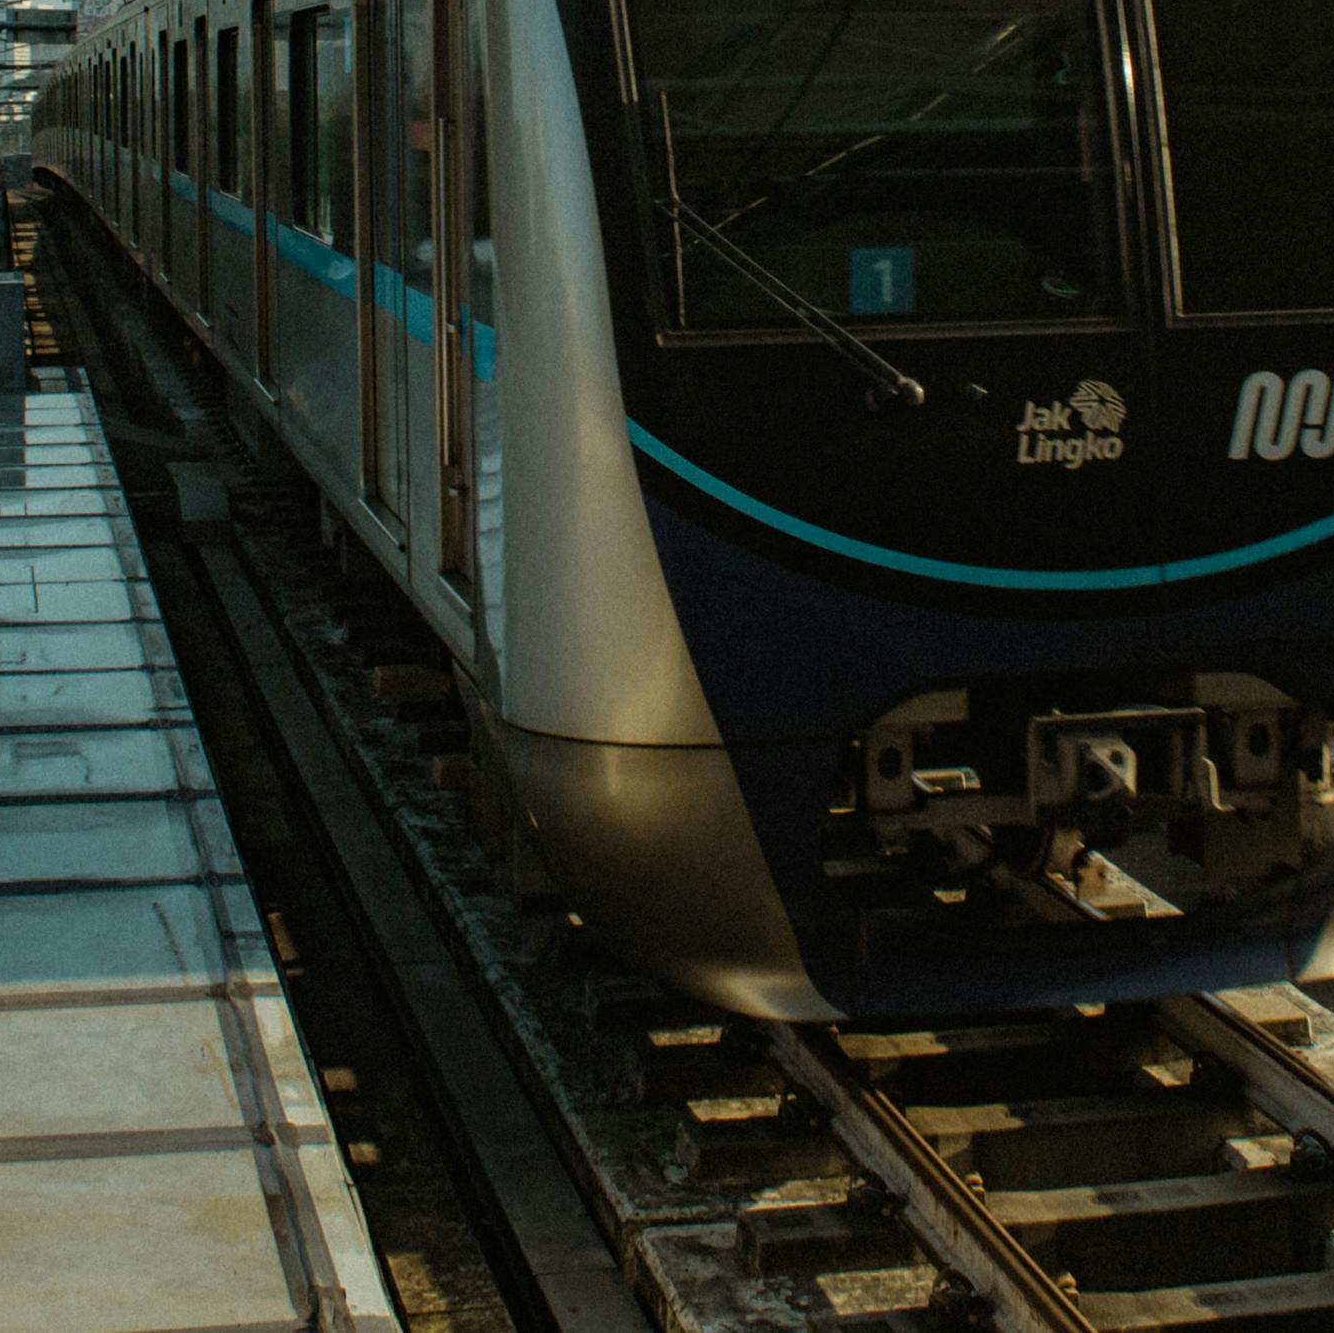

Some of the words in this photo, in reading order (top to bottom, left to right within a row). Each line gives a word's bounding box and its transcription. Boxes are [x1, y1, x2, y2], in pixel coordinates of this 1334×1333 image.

[873, 258, 894, 303] 1
[1017, 400, 1072, 433] Jak
[1017, 432, 1124, 469] Lingko
